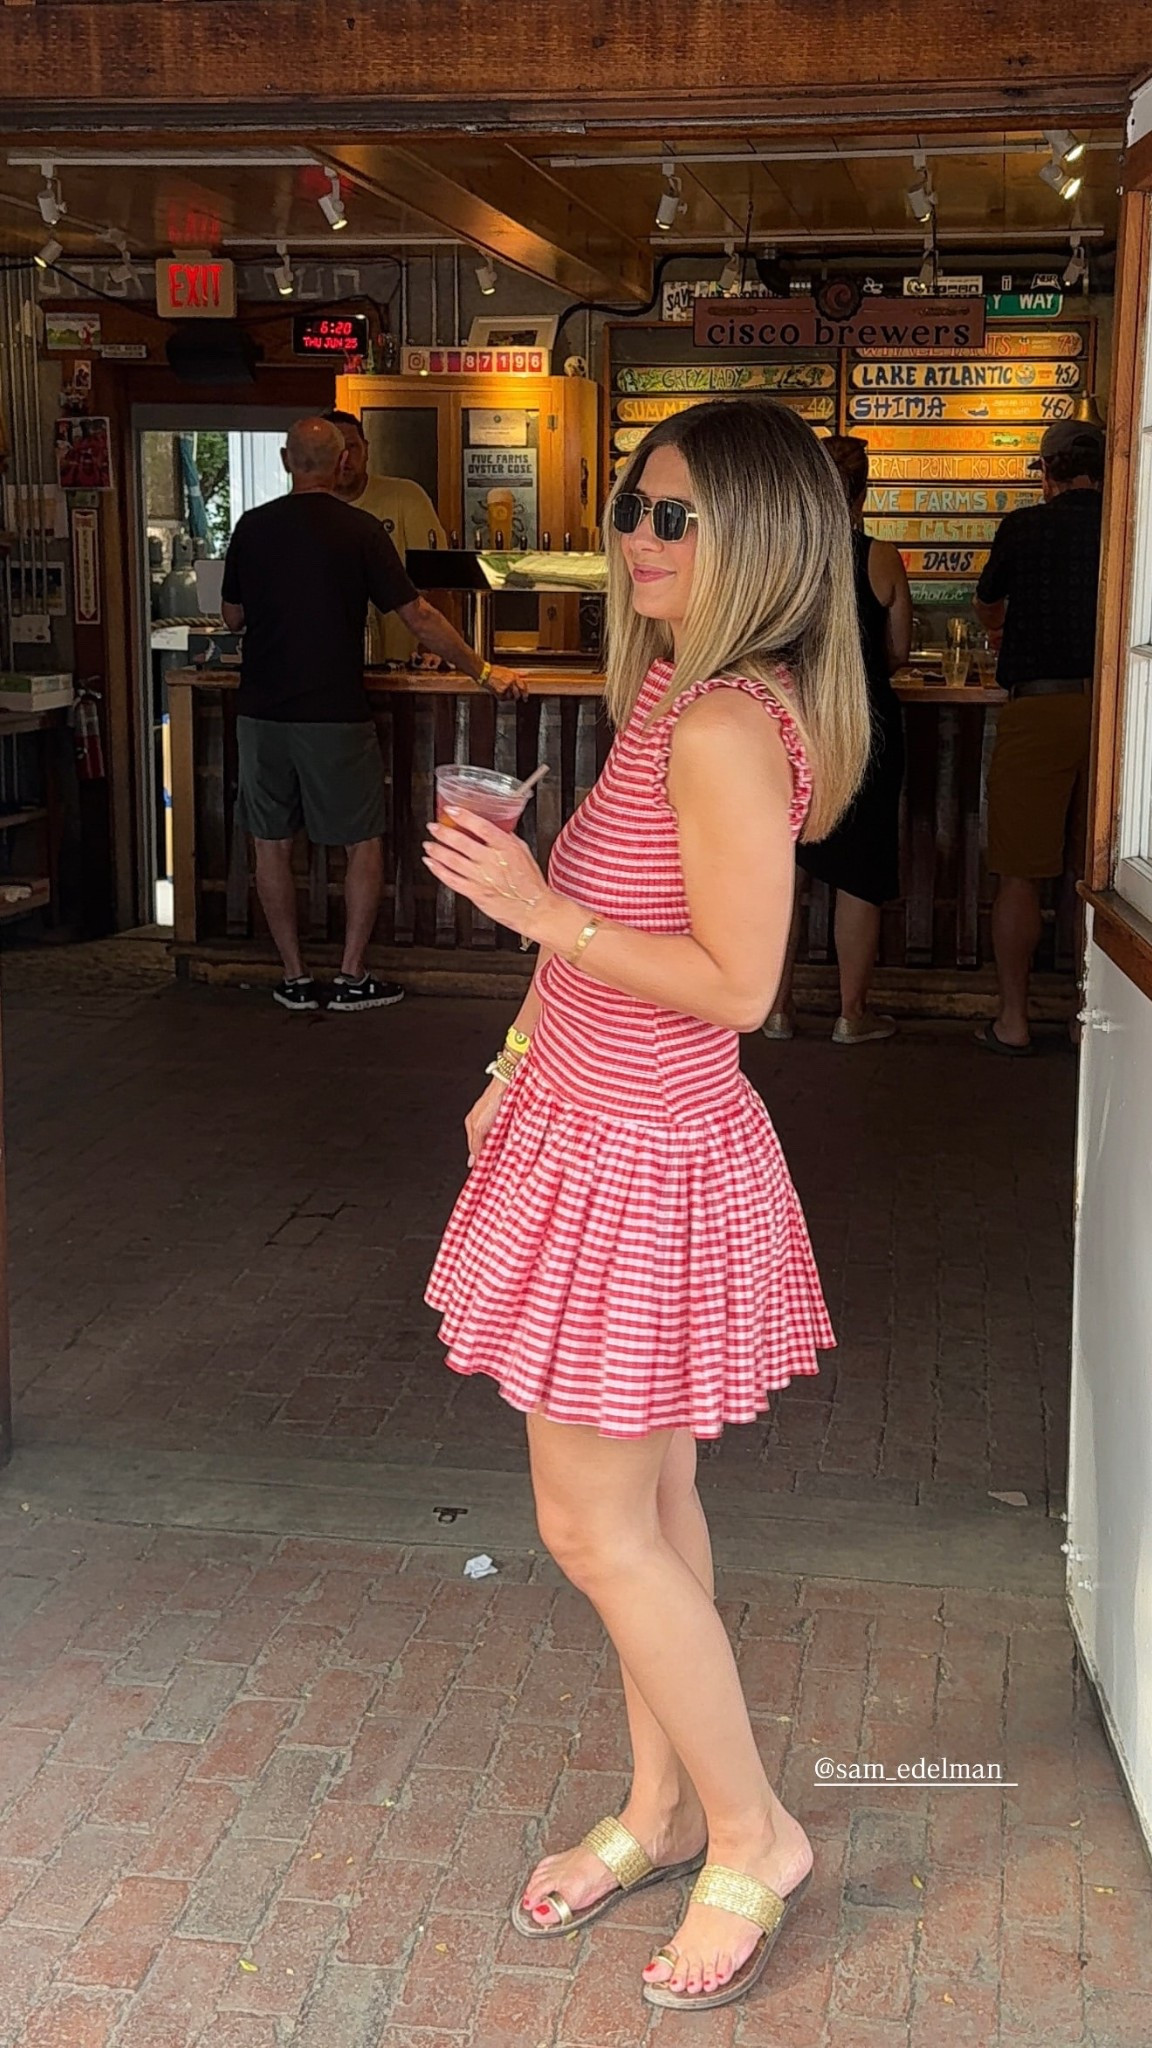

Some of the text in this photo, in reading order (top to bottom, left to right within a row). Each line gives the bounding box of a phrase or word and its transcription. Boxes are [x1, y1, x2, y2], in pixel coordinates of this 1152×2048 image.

[168, 264, 223, 308] EXIT
[1019, 294, 1054, 309] WAY
[320, 321, 352, 335] 6:20
[707, 318, 800, 345] cisco
[815, 317, 970, 345] brewers
[303, 336, 322, 349] THU
[324, 337, 342, 349] JUN
[662, 367, 744, 389] GREY LADY
[861, 365, 916, 386] LAKE
[924, 365, 1013, 386] ATLANTIC
[854, 395, 946, 418] SHIMA
[468, 464, 504, 474] OYSTER
[471, 454, 528, 464] FIVE FARMS
[920, 457, 962, 478] POINT
[915, 490, 988, 511] FARMS
[922, 551, 974, 571] DAYS
